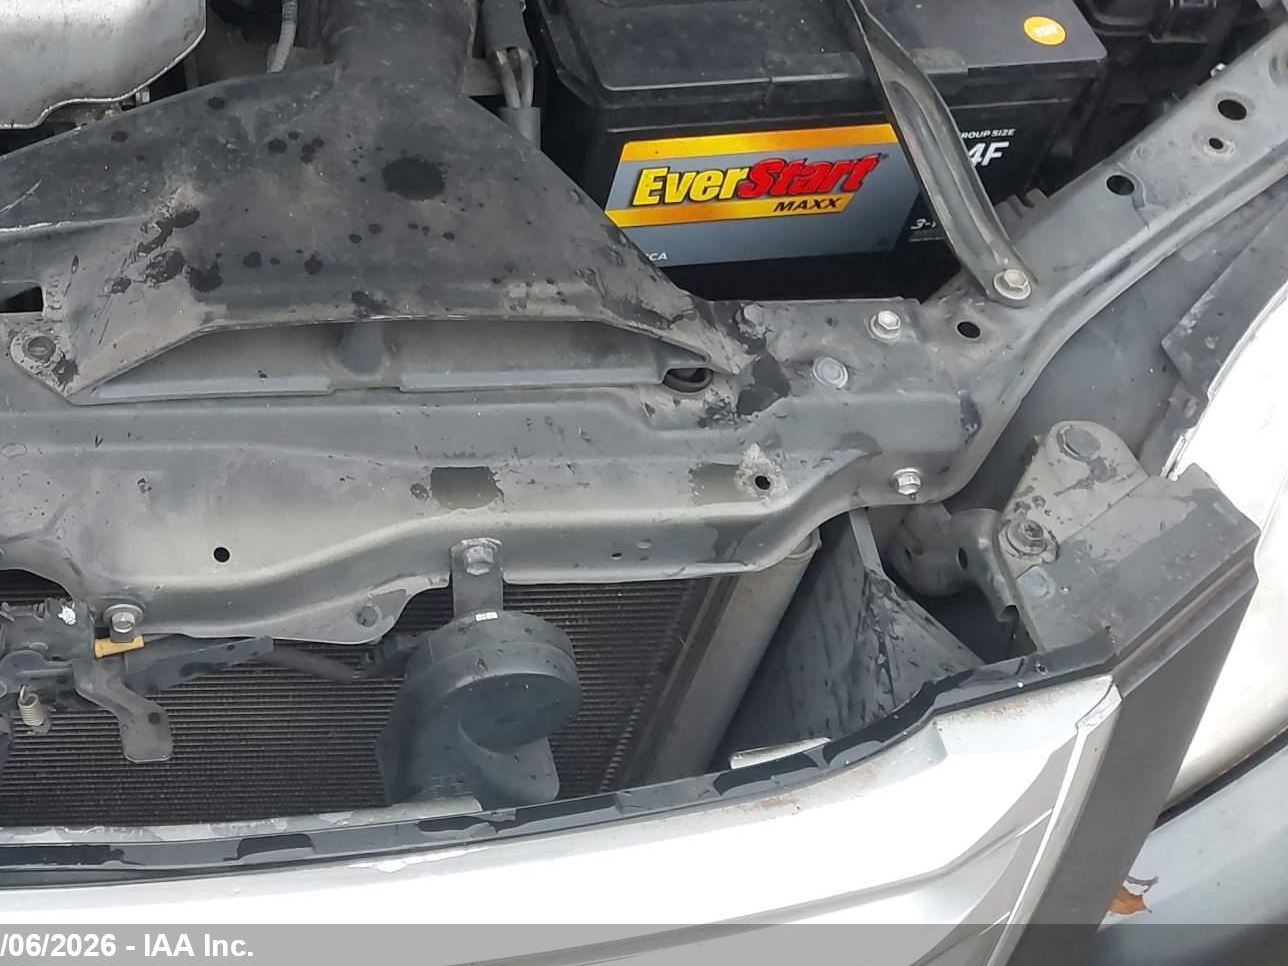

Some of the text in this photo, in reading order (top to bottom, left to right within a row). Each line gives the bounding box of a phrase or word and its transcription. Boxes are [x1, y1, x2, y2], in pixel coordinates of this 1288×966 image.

[960, 129, 1016, 139] ROUP SIZE
[968, 141, 1010, 167] 4F
[632, 153, 882, 206] EverStart
[773, 197, 842, 213] MAXX
